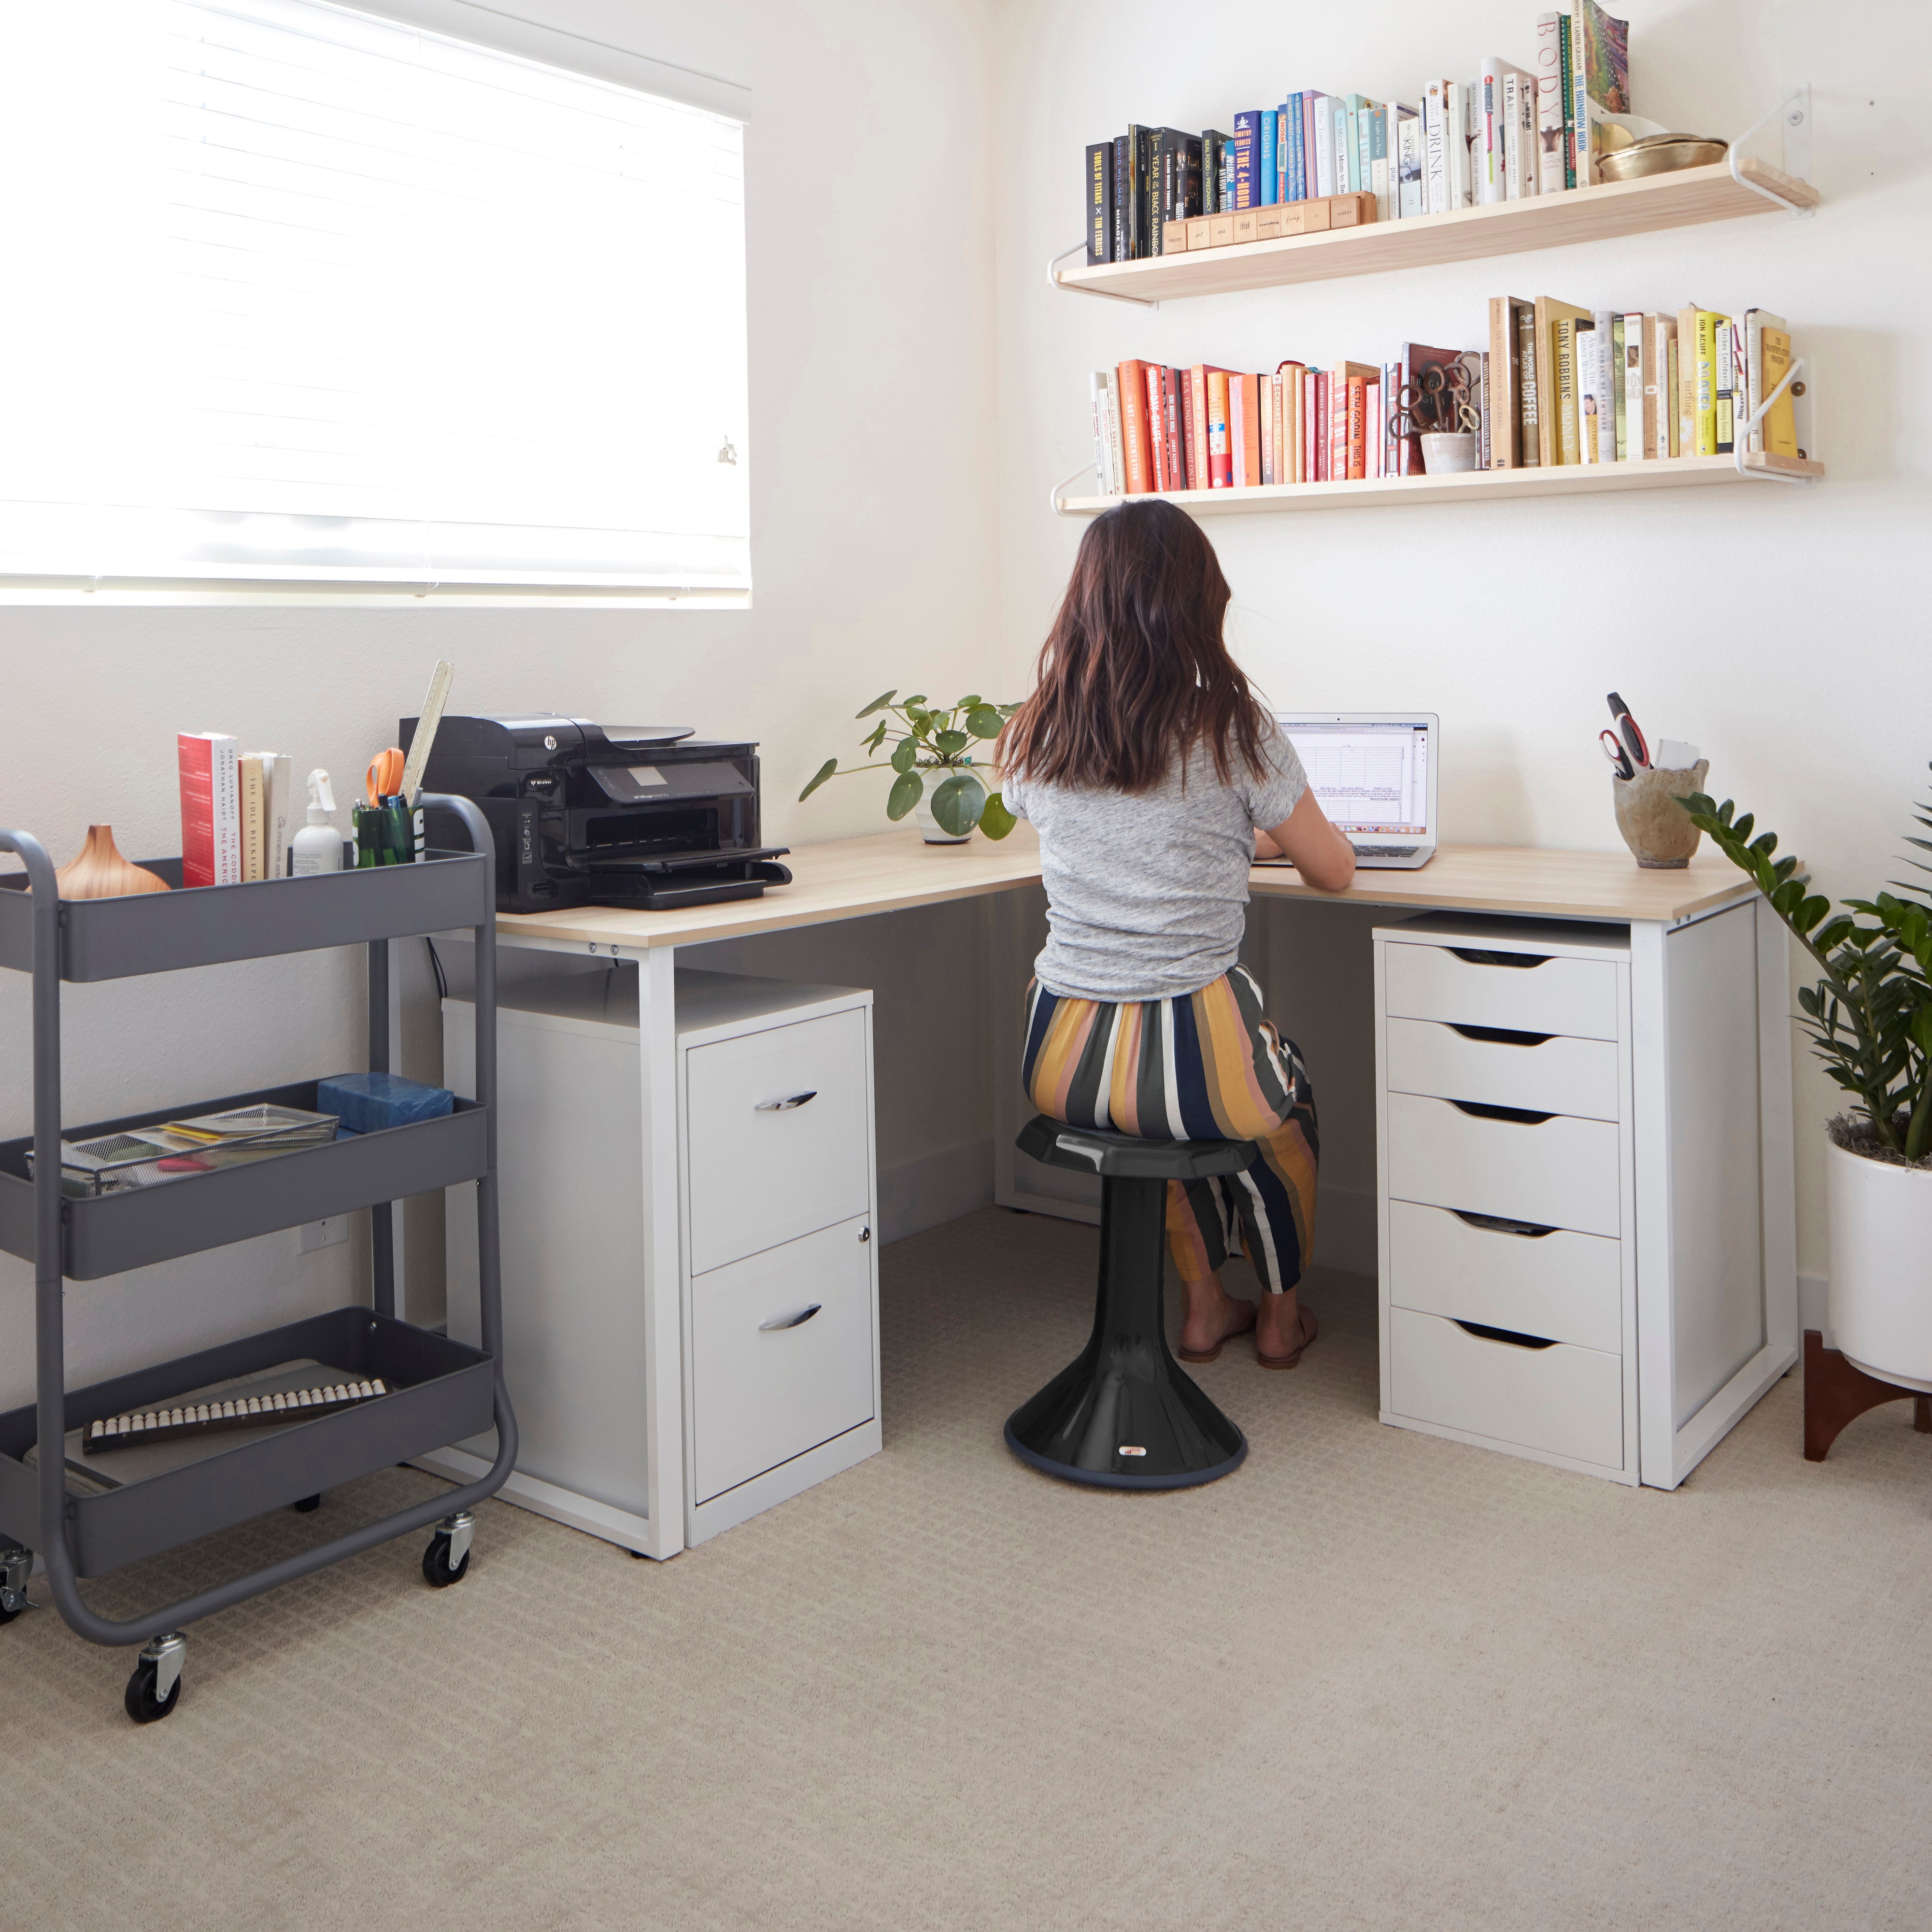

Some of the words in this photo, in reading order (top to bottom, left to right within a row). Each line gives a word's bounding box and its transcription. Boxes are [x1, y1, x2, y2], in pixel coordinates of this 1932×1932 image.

[1538, 22, 1558, 116] BODY
[1575, 73, 1584, 90] THE
[1506, 79, 1515, 127] TRANNY
[1575, 90, 1586, 129] RAINBOW
[1235, 130, 1251, 139] TIMOTHY
[1235, 139, 1251, 147] FERRISS
[1577, 131, 1587, 154] BOOK
[1094, 151, 1102, 172] TOOLS
[1237, 151, 1250, 169] THE
[1403, 139, 1412, 165] KING
[1430, 124, 1443, 181] DRINK
[1226, 156, 1235, 183] INFLUENCE
[1237, 172, 1250, 208] 4-HOUR
[1240, 221, 1250, 230] think
[1558, 321, 1569, 349] TONY
[1765, 343, 1789, 357] MANIFESTATION
[1771, 355, 1785, 365] PROCESS
[1523, 371, 1528, 380] OF
[1558, 354, 1571, 400] ROBBINS
[1626, 375, 1641, 386] VEIN
[1696, 362, 1710, 377] DO
[1350, 385, 1361, 408] SETH
[1522, 382, 1537, 426] COFFEE
[1627, 388, 1641, 399] GOLD
[1683, 381, 1695, 416] birthing
[1697, 380, 1711, 411] OVER
[1196, 412, 1202, 421] OF
[1350, 410, 1361, 440] GODIN
[1563, 405, 1574, 451] MONEY
[1128, 426, 1139, 480] FERMENTATION
[1188, 465, 1194, 476] ON
[277, 816, 286, 829] The
